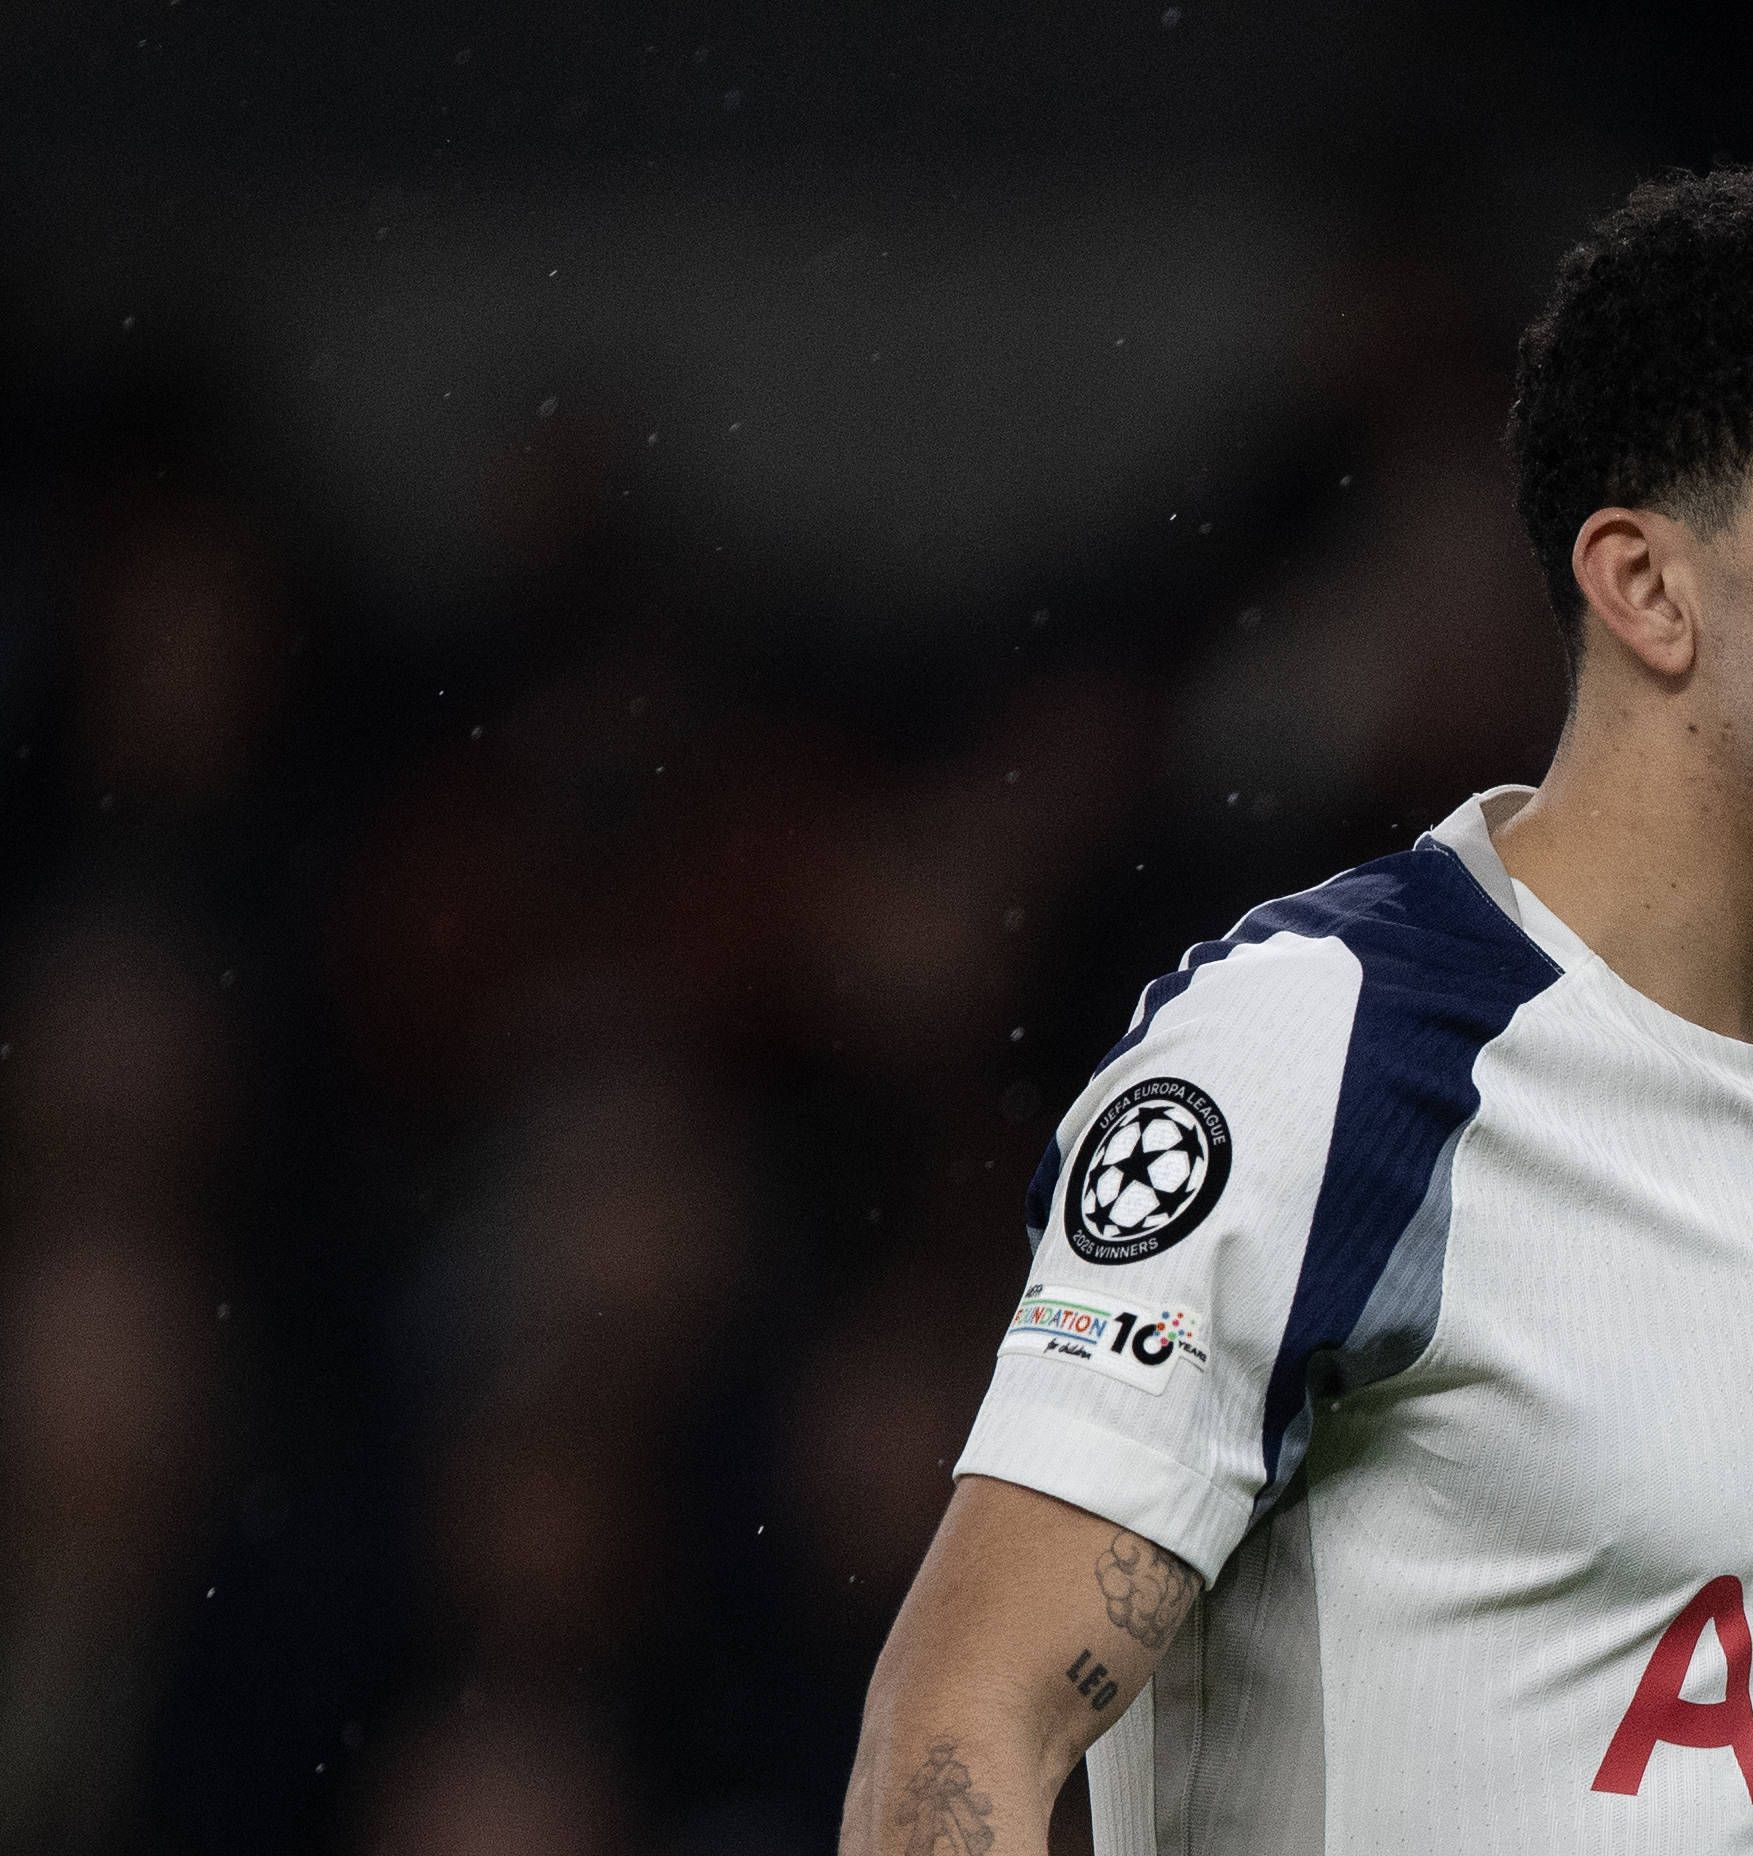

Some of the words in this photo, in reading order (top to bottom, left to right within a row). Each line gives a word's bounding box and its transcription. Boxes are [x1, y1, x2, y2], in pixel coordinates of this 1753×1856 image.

[1099, 1098, 1131, 1129] UEFA
[1133, 1082, 1186, 1101] EUROPA
[1187, 1092, 1227, 1146] LEAGUE
[1072, 1229, 1094, 1254] 2025
[1095, 1237, 1159, 1259] WINNERS
[1111, 1311, 1174, 1366] 10
[1178, 1340, 1207, 1363] YEARS
[1066, 1647, 1118, 1713] LEO
